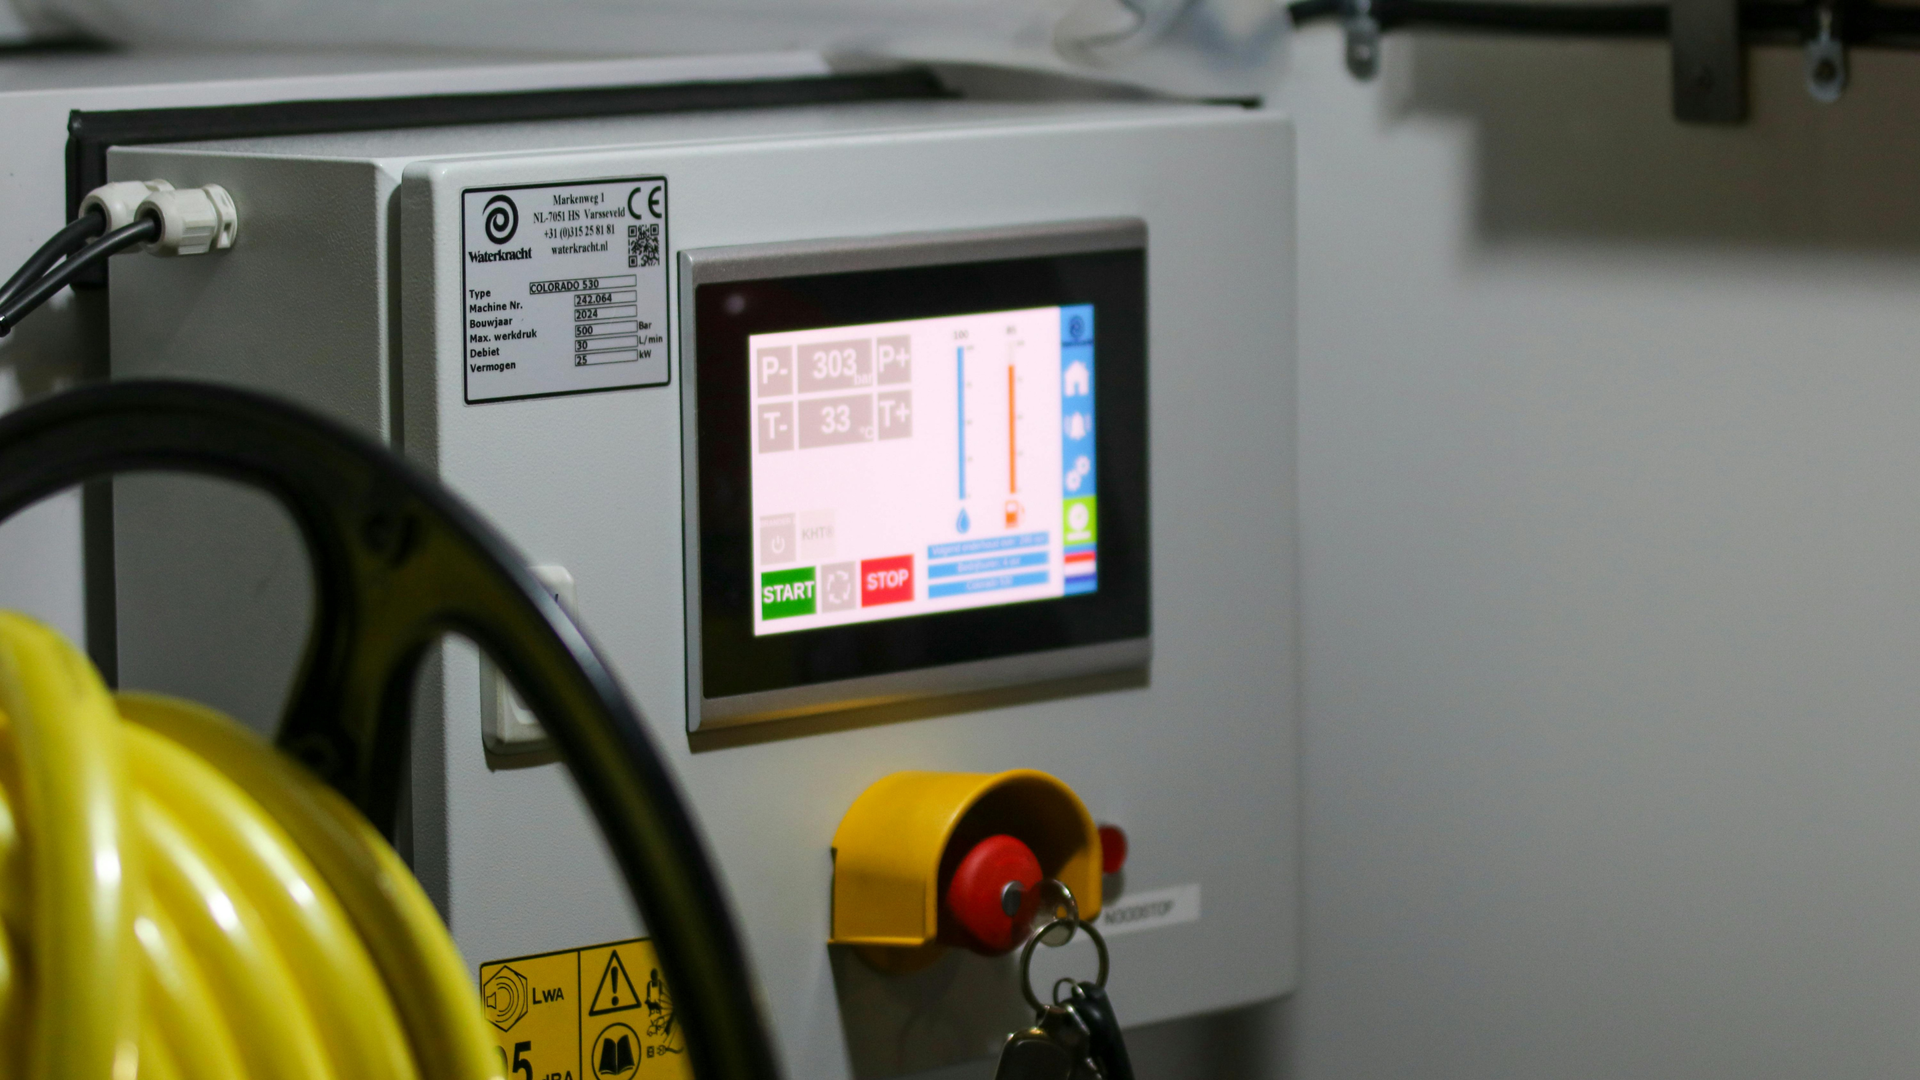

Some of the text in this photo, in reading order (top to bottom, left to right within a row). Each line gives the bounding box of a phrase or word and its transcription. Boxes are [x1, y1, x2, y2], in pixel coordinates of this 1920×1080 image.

[553, 193, 605, 206] Markenweg 1
[627, 185, 662, 220] CE
[533, 207, 626, 224] NL-7051 HS Varsseveld
[544, 224, 615, 240] +31 (0)315 25 81 81
[551, 241, 608, 255] waterkracht.nl
[468, 247, 533, 264] Waterkracht
[530, 279, 600, 294] COLORADO 530
[469, 289, 491, 300] Type
[576, 294, 612, 305] 242.064
[470, 300, 523, 313] Machine Nr.
[576, 309, 598, 319] 2024
[470, 316, 512, 329] Bouwjaar
[639, 321, 652, 330] Bar
[470, 328, 537, 344] Max. werkdruk
[576, 326, 594, 336] 500
[576, 341, 588, 350] 30
[639, 334, 663, 345] L/min
[470, 347, 500, 358] Debiet
[639, 350, 652, 359] kW
[878, 344, 910, 373] P+
[470, 361, 516, 373] Vermogen
[576, 355, 587, 365] 25
[812, 348, 857, 380] 303
[762, 356, 789, 384] P-
[854, 372, 873, 386] bar
[821, 404, 851, 434] 33
[879, 400, 910, 428] T+
[763, 411, 788, 440] T-
[867, 569, 909, 591] STOP
[763, 581, 815, 603] START
